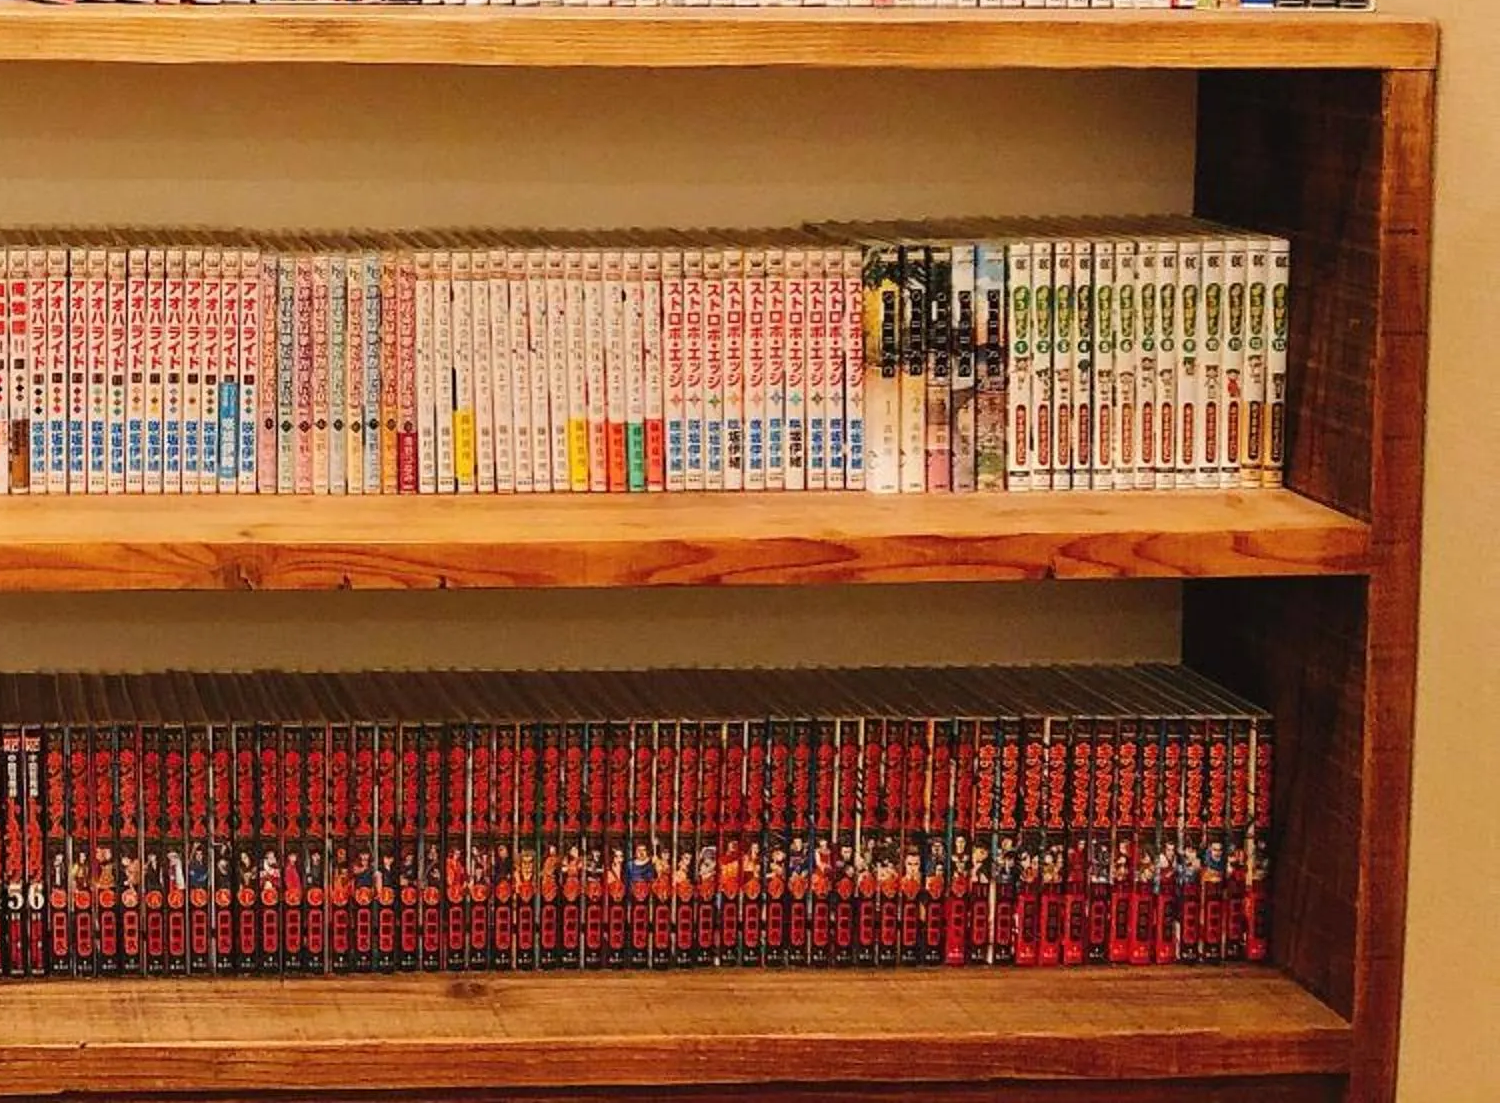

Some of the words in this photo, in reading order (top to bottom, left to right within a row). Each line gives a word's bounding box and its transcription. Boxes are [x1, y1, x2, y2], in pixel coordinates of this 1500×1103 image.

[32, 281, 45, 370] アオハライド
[71, 280, 85, 370] アオハライド
[91, 280, 105, 370] アオハライド
[131, 280, 144, 369] アオハライド
[150, 281, 163, 369] アオハライド
[168, 281, 182, 369] アオハライド
[205, 282, 219, 370] アオハライド
[224, 282, 237, 370] アオハライド
[243, 282, 257, 371] アオハライド
[668, 282, 682, 388] ストロボ・エッジ
[687, 282, 701, 387] ストロボ・エッジ
[727, 281, 741, 386] ストロボ・エッジ
[750, 282, 763, 387] ストロボ・エッジ
[769, 280, 784, 386] ストロボ・エッジ
[810, 282, 823, 387] ストロボ・エッジ
[829, 280, 843, 386] ストロボ・エッジ
[849, 282, 863, 387] ストロボ・エッジ
[7, 885, 24, 910] 5
[28, 885, 45, 911] 6
